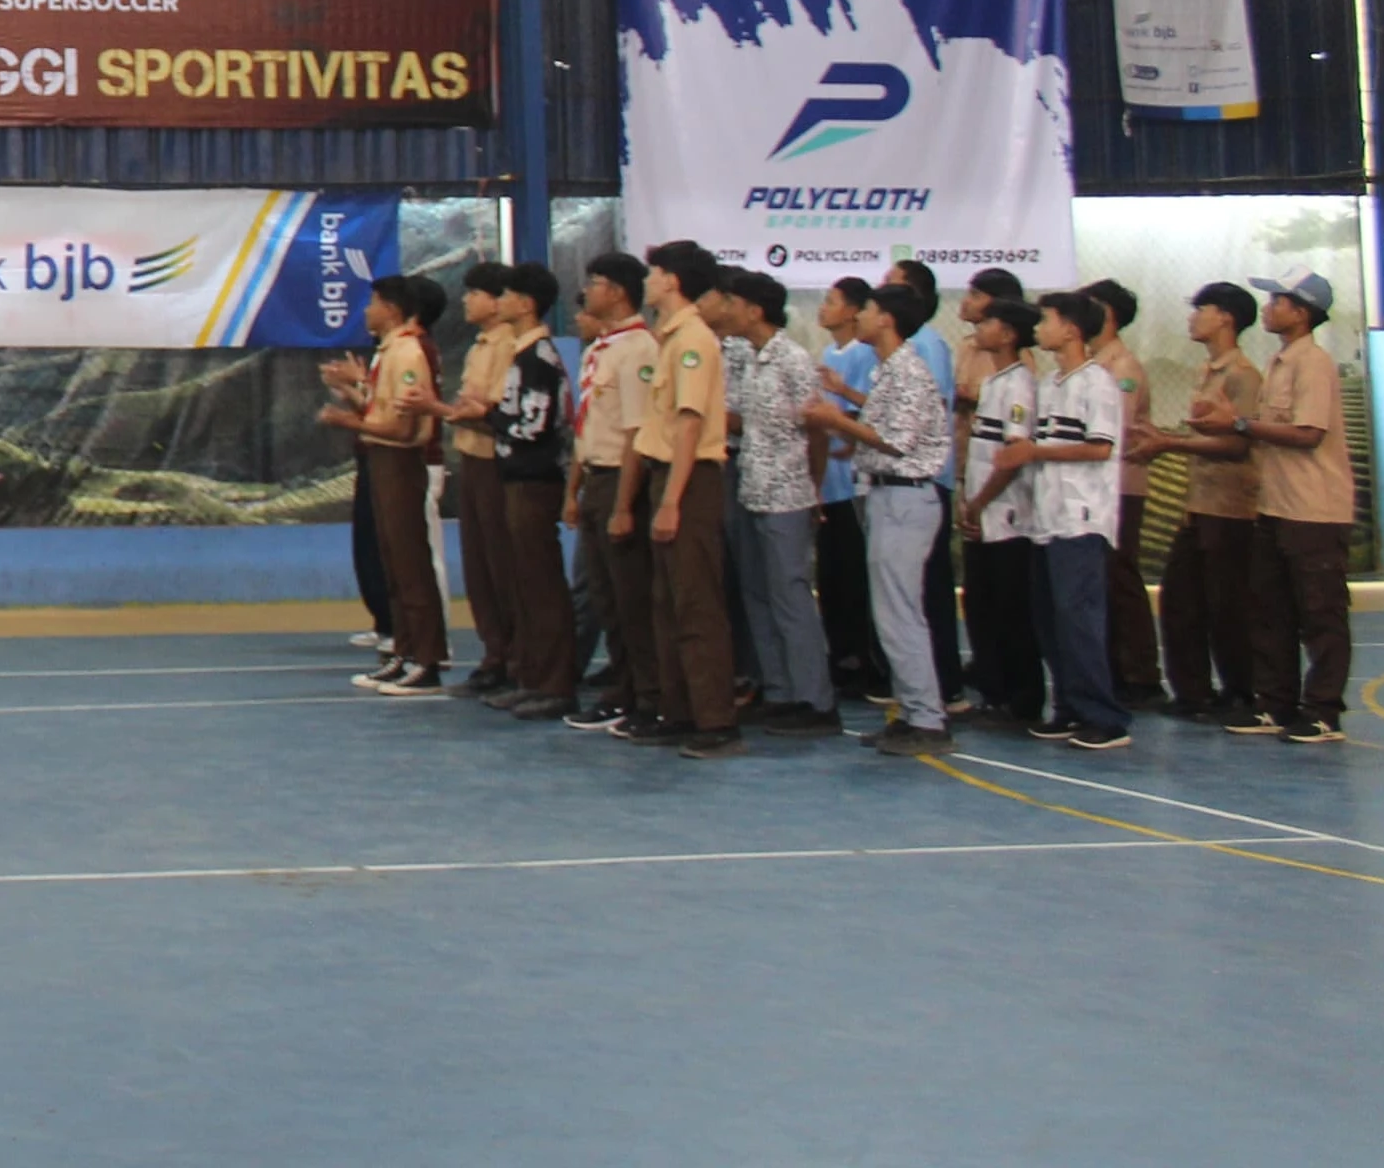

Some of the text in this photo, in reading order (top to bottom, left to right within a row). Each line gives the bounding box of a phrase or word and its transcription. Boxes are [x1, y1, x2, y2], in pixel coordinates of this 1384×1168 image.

[97, 47, 470, 100] SPORTIVITAS
[744, 187, 930, 210] POLYCLOTH
[766, 215, 912, 229] SPORTSWEAR
[25, 243, 115, 301] bjb
[318, 213, 349, 328] bank bjb
[794, 249, 1039, 264] POLYCLOTH 08987559692
